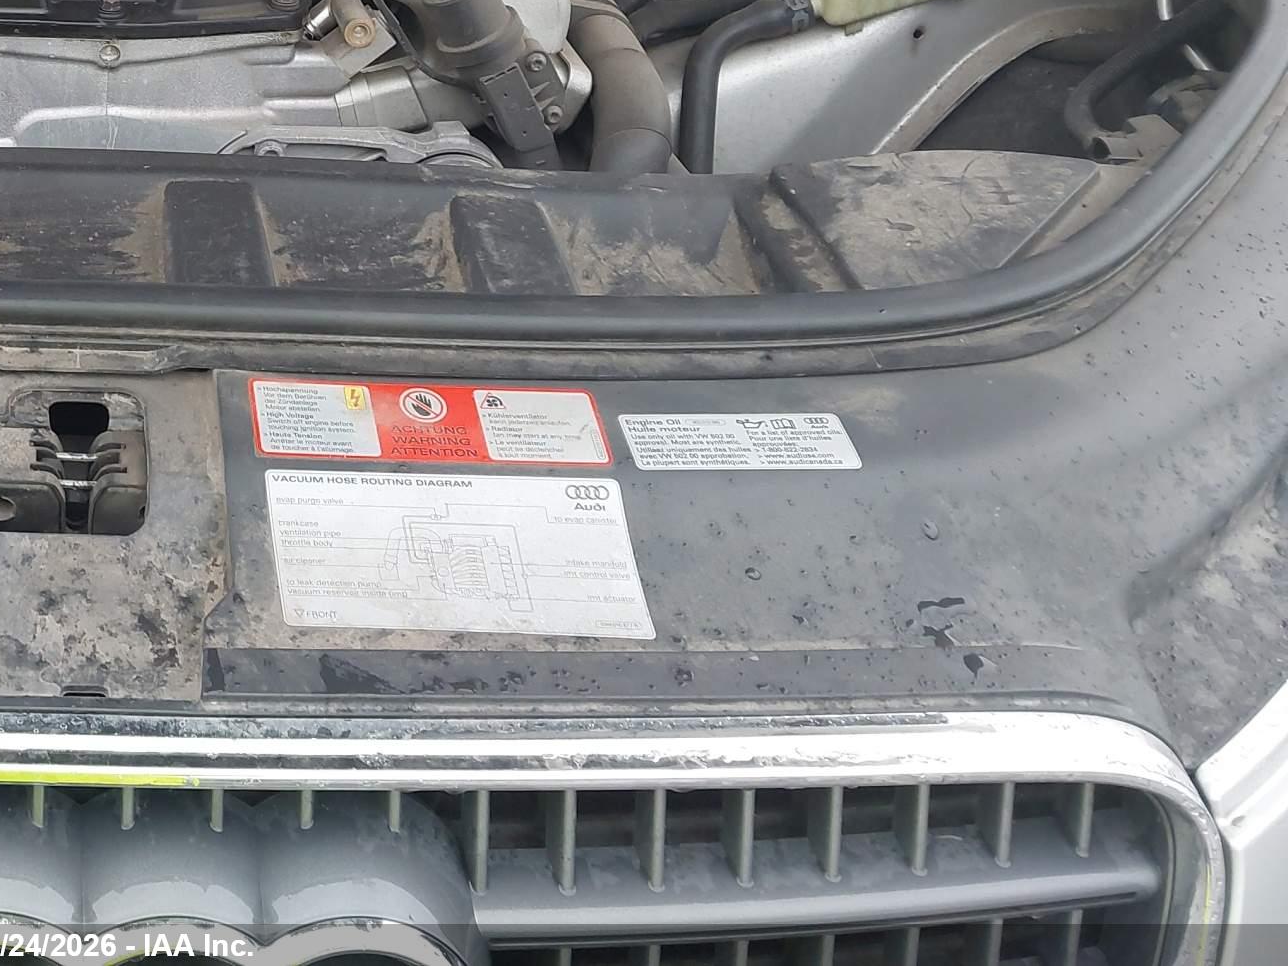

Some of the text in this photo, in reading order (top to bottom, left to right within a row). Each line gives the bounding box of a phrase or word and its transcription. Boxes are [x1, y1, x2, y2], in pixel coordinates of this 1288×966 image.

[624, 419, 664, 427] Engine
[666, 418, 681, 426] Oil
[392, 425, 468, 434] ACHTUNG
[294, 432, 322, 440] Tension
[392, 436, 470, 445] WARNING
[392, 446, 478, 457] ATTENTION
[272, 474, 472, 488] VACUUM HOSE ROUTING DIAGRAM
[574, 502, 606, 512] Audi
[280, 528, 342, 538] ventilation pipe
[282, 538, 332, 548] throttle body
